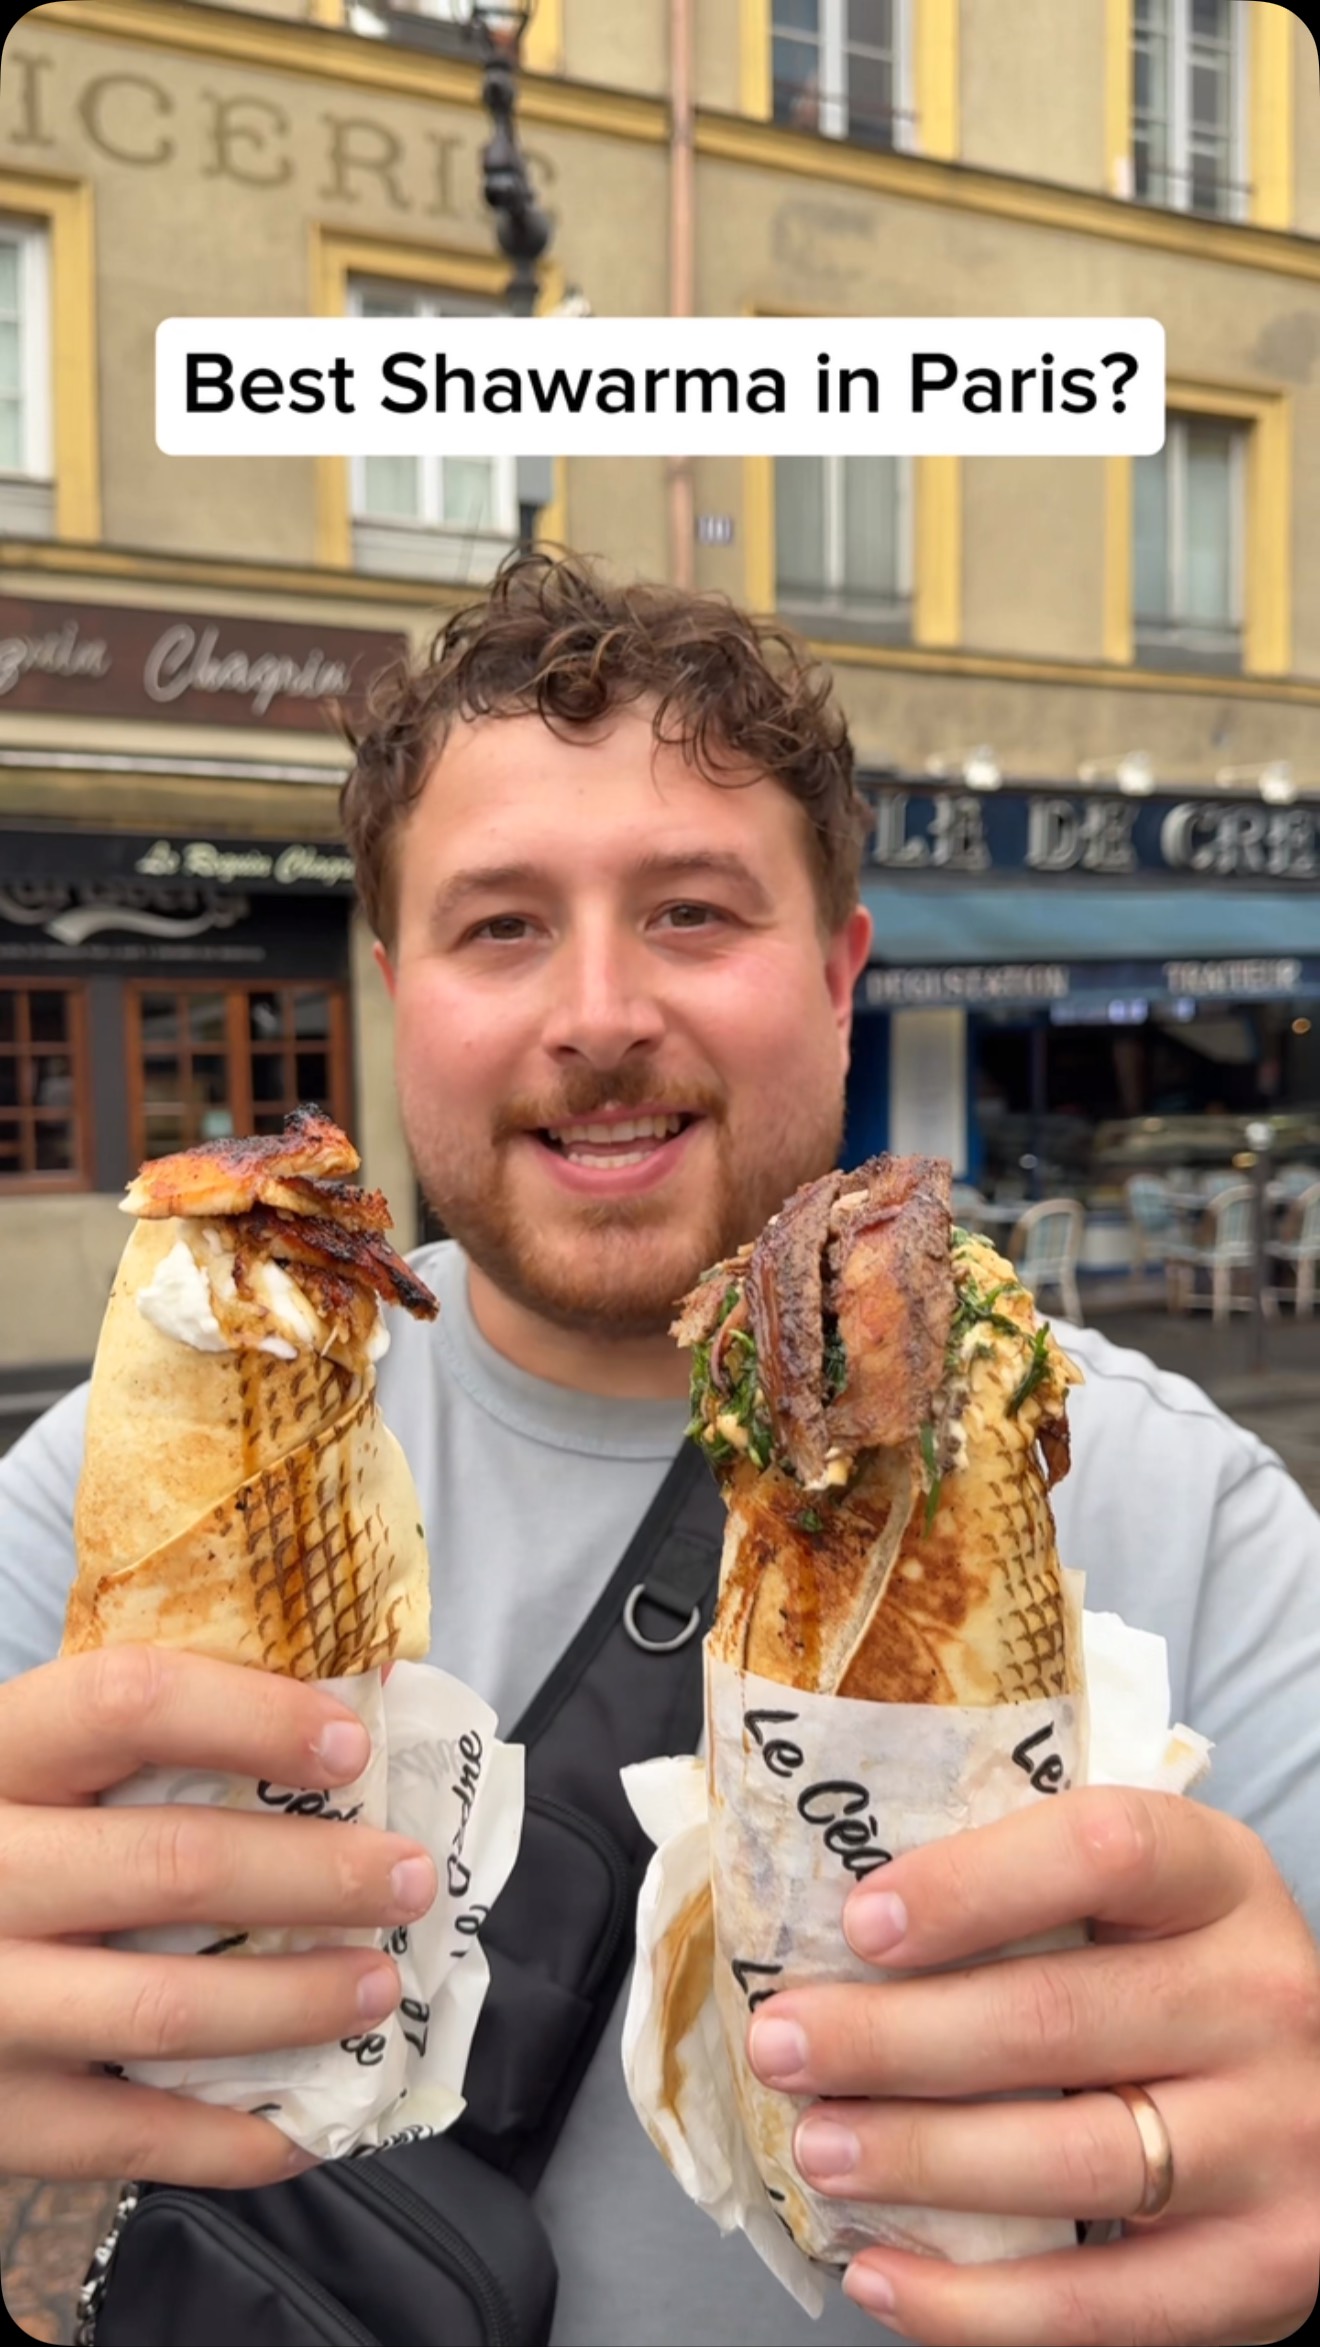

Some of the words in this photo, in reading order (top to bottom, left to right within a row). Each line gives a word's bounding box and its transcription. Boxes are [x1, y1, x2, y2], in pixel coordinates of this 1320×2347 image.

[1025, 797, 1138, 872] DE
[744, 1710, 804, 1778] Le
[1011, 1720, 1064, 1795] Le
